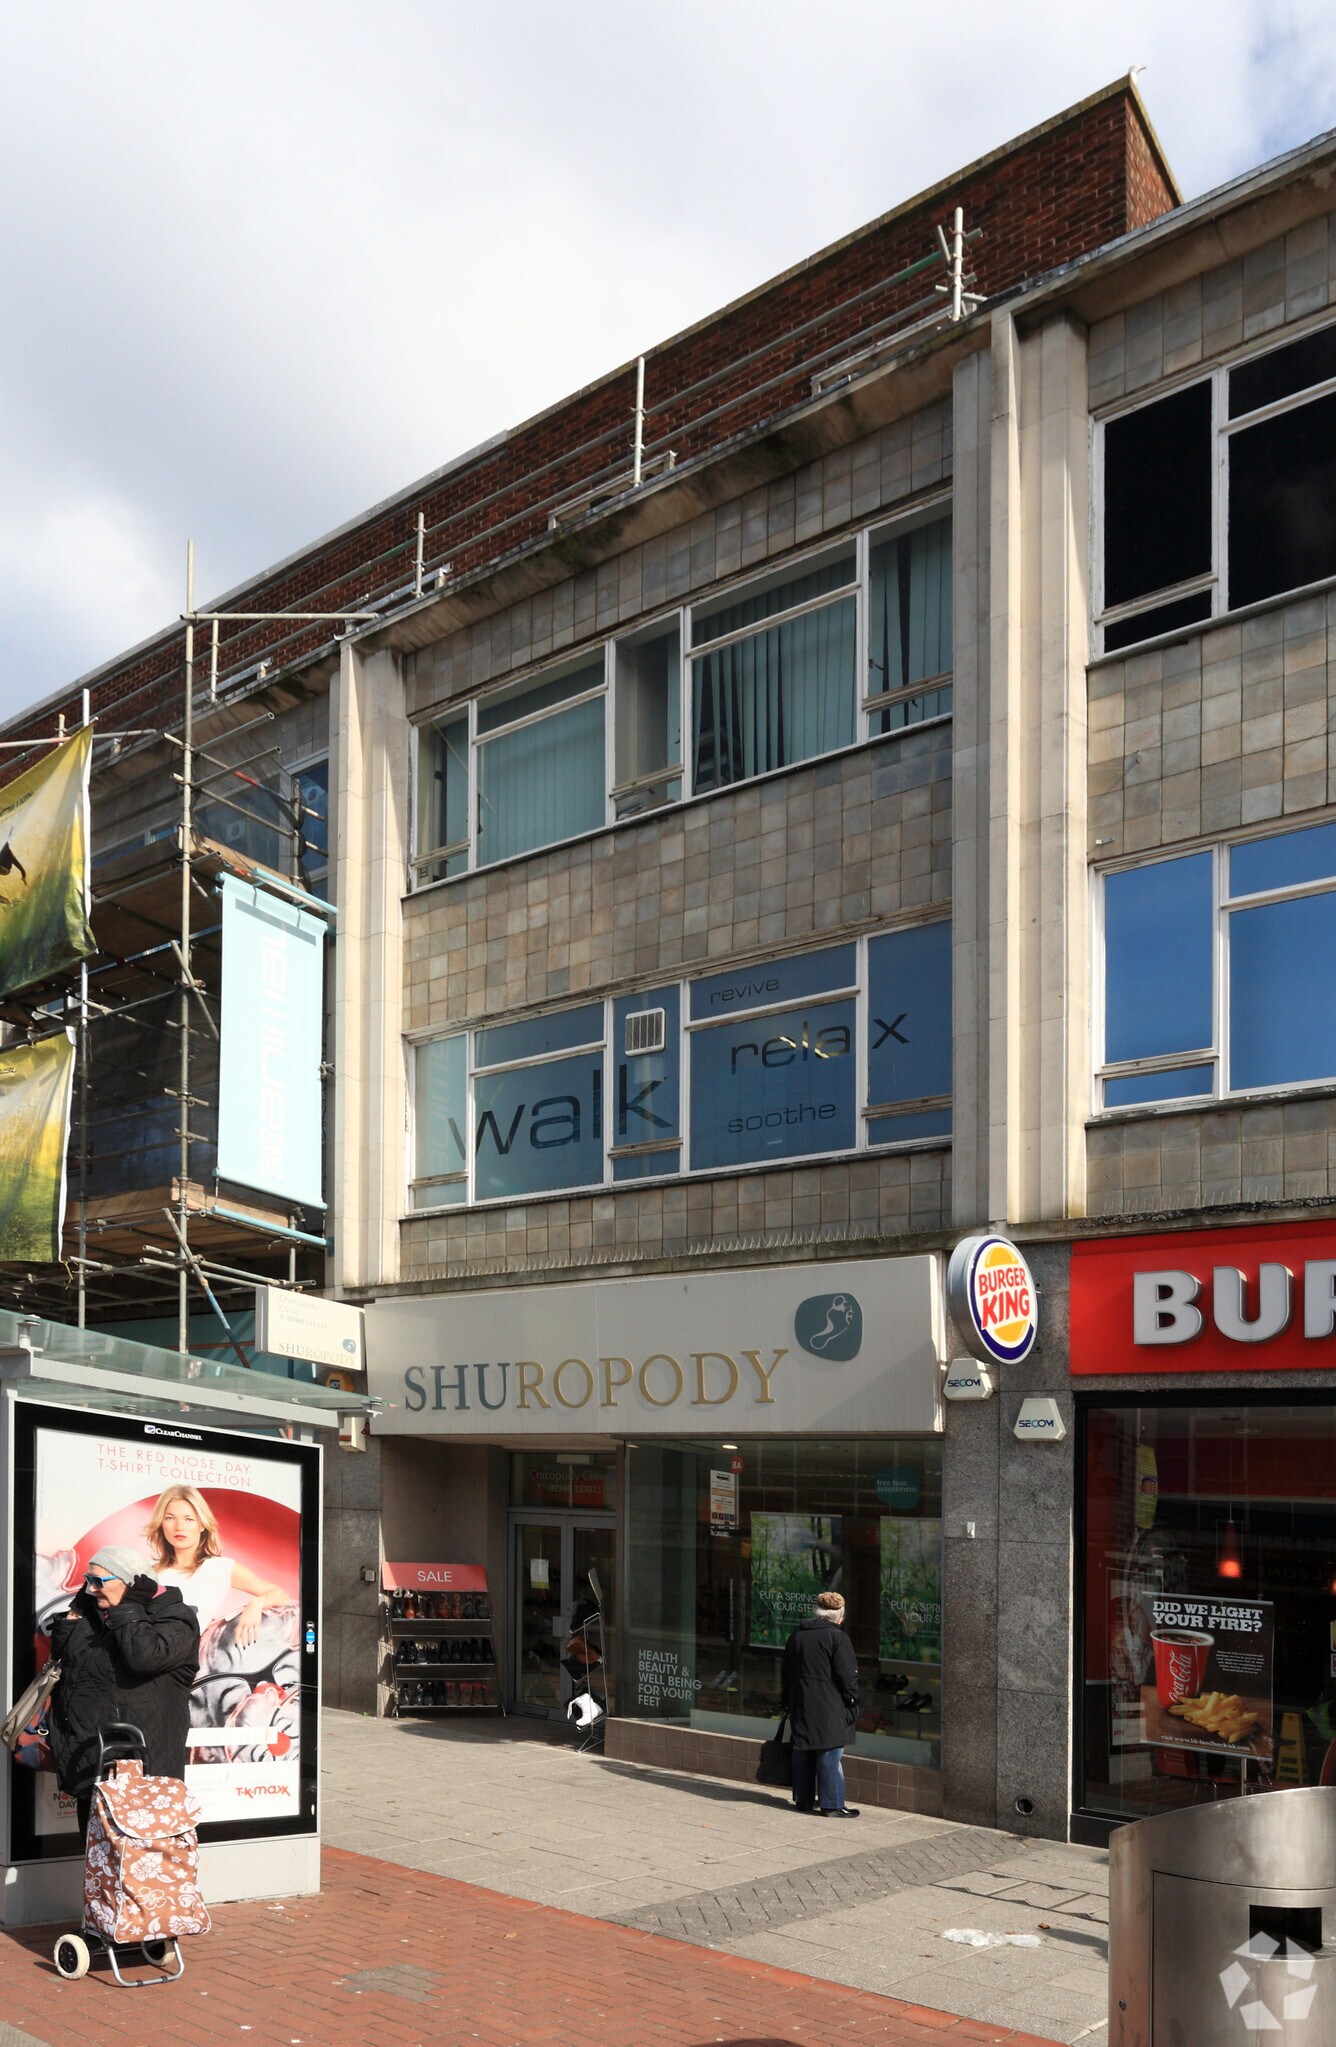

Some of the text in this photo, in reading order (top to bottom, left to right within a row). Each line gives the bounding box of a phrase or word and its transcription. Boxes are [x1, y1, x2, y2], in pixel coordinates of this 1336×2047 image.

[709, 978, 780, 1005] revive
[731, 1012, 910, 1074] relax
[447, 1064, 674, 1160] walk
[728, 1102, 836, 1134] soothe
[978, 1267, 1027, 1296] BURGER
[981, 1287, 1030, 1329] KING
[278, 1342, 356, 1366] SHUROPODY
[404, 1348, 790, 1412] SHUROPODY
[947, 1378, 981, 1387] SECOM
[1018, 1419, 1055, 1428] SECOM
[97, 1443, 251, 1474] THE RED NOSE DAY
[97, 1458, 251, 1487] T-SHIRT COLLECTION
[876, 1479, 907, 1487] free foot
[417, 1570, 453, 1582] SALE
[759, 1590, 775, 1600] PUT
[776, 1592, 784, 1601] A
[771, 1601, 797, 1612] YOUR
[890, 1600, 908, 1611] PUT
[910, 1602, 918, 1611] A
[1152, 1601, 1263, 1620] DID WE LIGHT
[904, 1612, 933, 1624] YOUR
[1152, 1612, 1263, 1633] YOUR FIRE?
[638, 1649, 678, 1664] HEALTH
[638, 1661, 690, 1677] BEAUTY &
[638, 1672, 702, 1690] WELL BEING
[638, 1683, 692, 1700] FOR YOUR
[638, 1695, 661, 1707] FEET
[58, 1800, 78, 1809] DAY
